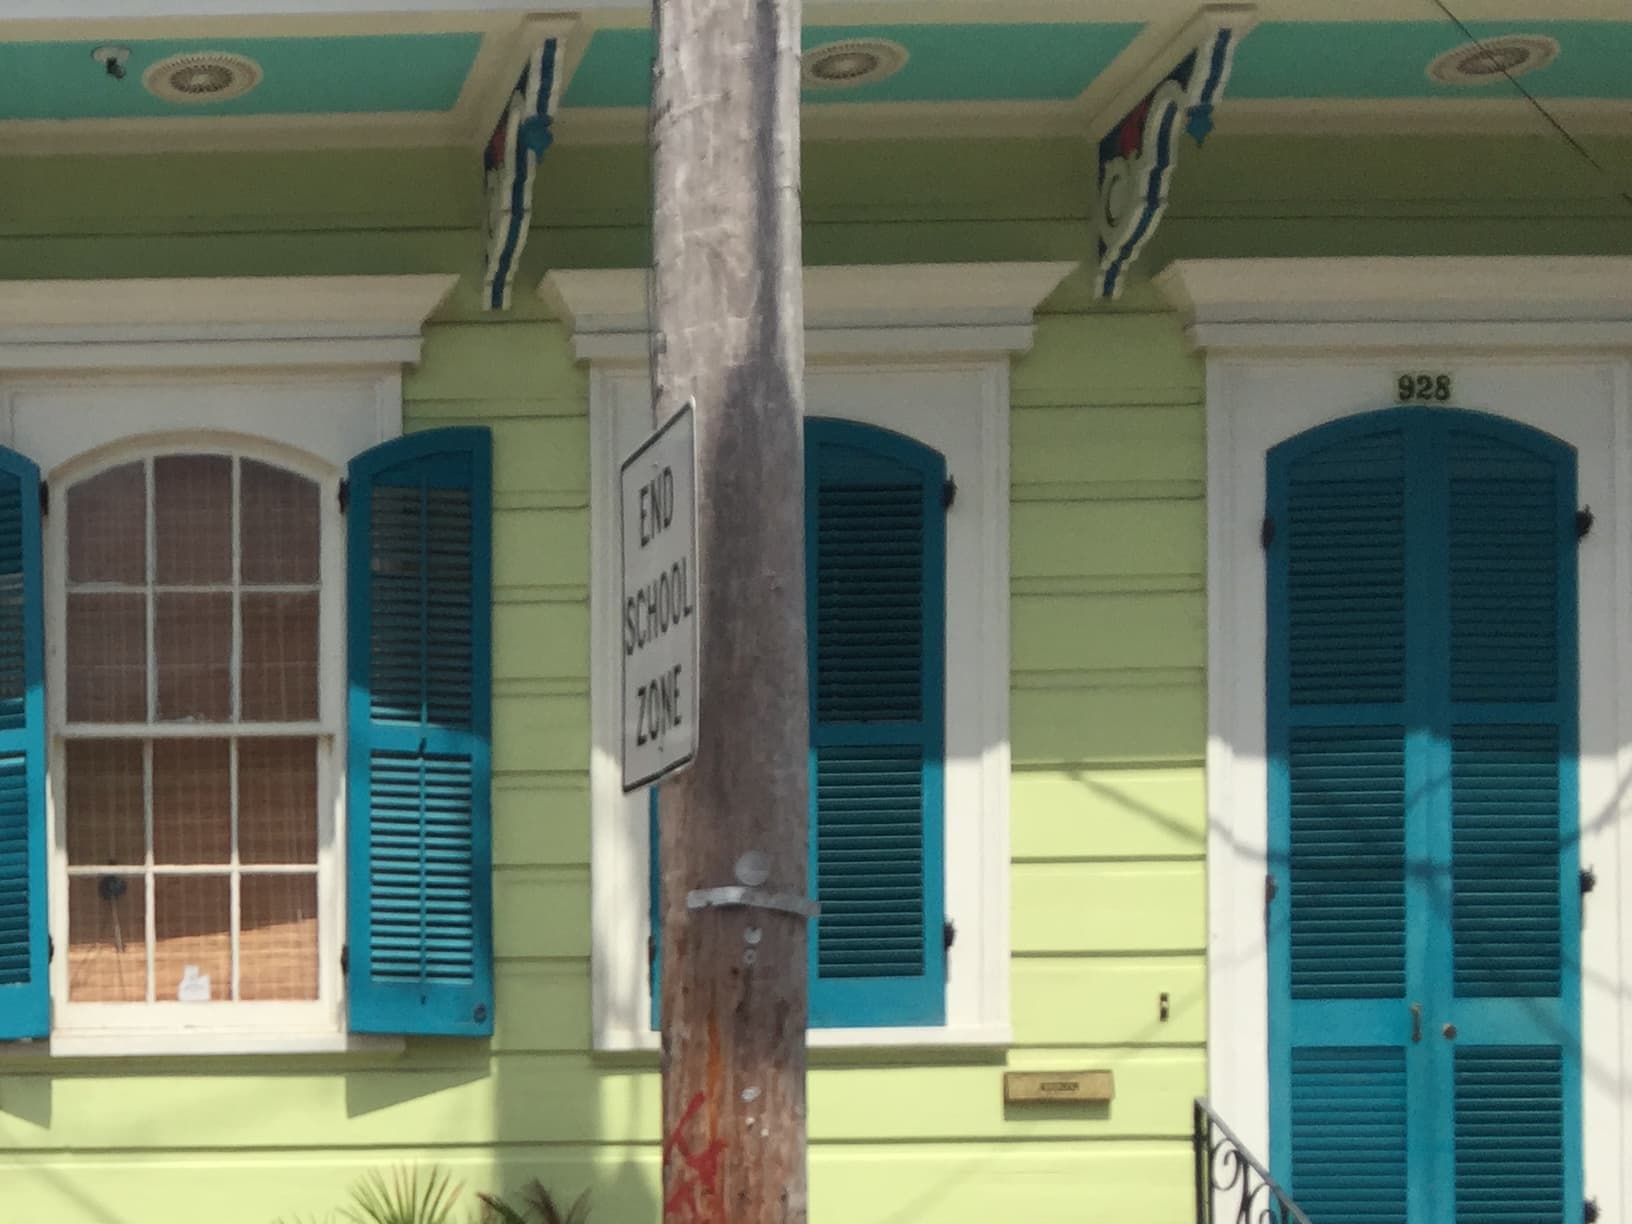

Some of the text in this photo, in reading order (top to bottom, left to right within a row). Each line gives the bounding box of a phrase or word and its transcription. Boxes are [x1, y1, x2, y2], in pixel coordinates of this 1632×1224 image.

[1399, 374, 1451, 401] 928
[639, 465, 674, 548] END
[625, 556, 694, 656] SCHOOL
[636, 664, 682, 746] ZONE
